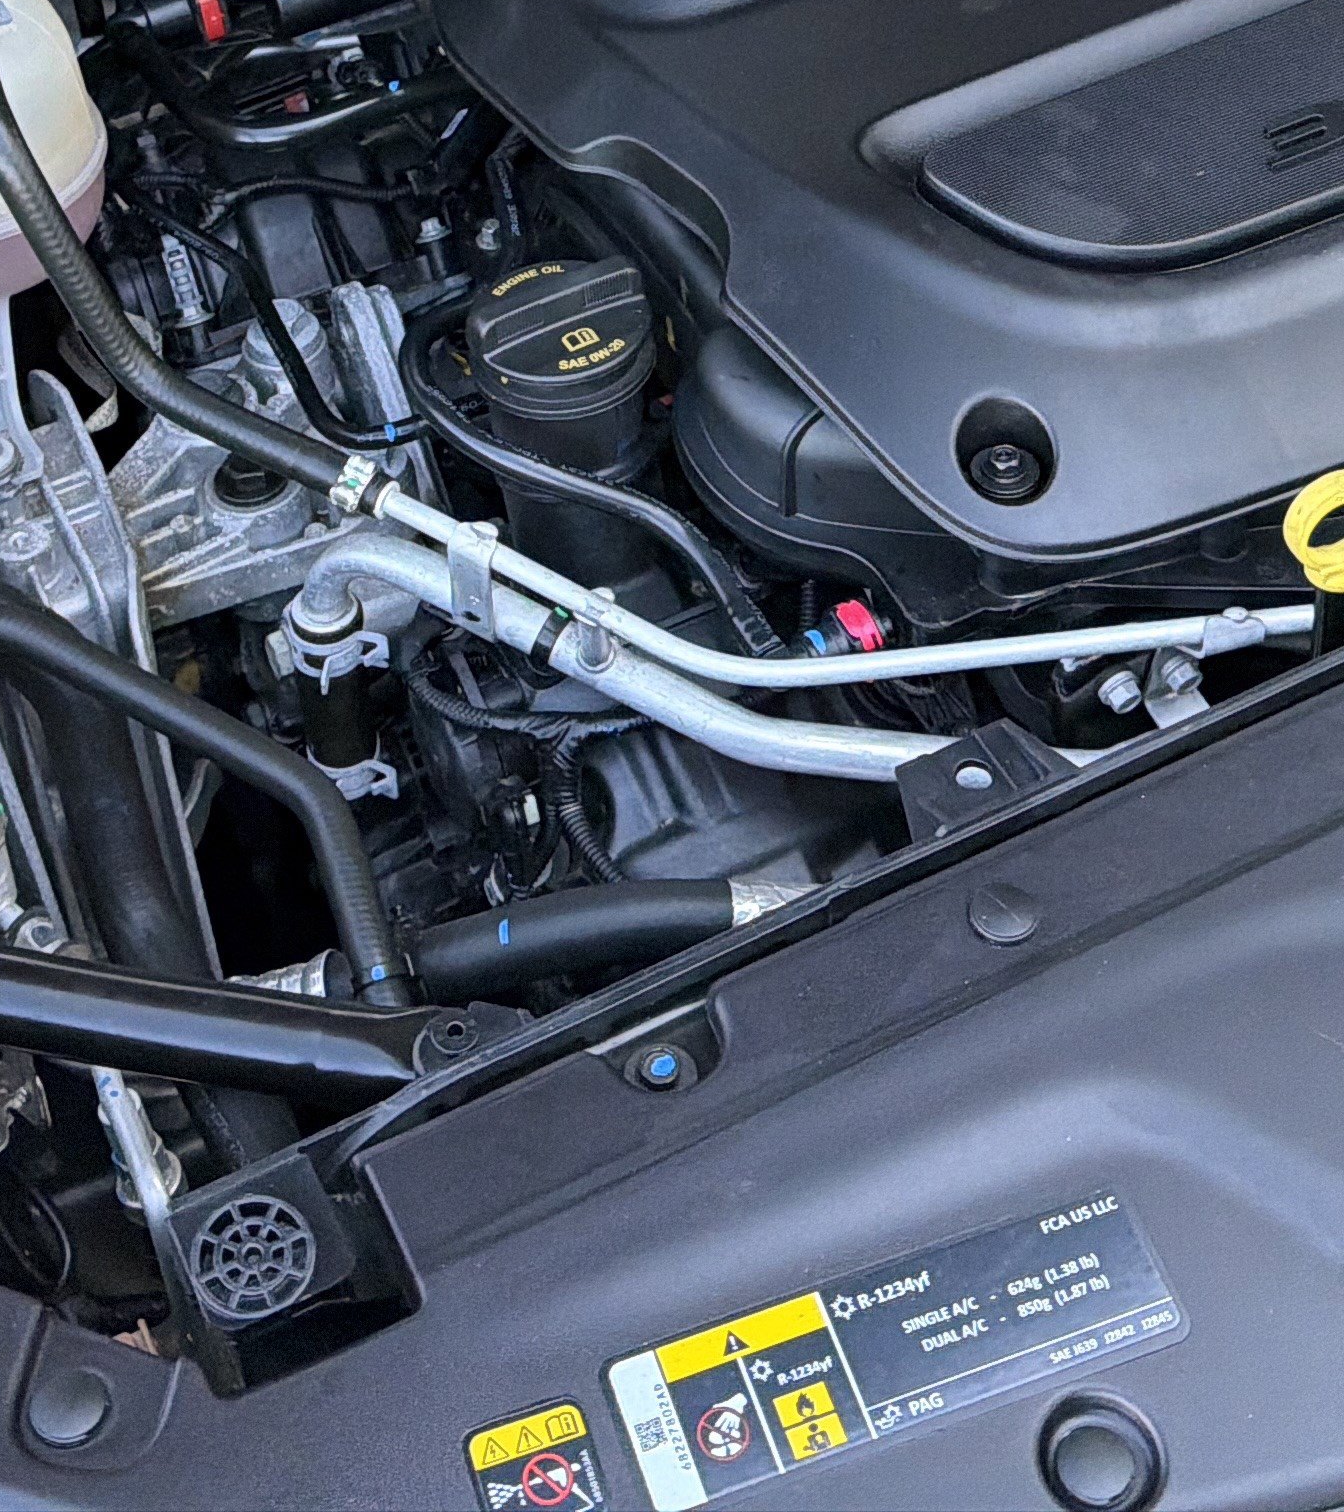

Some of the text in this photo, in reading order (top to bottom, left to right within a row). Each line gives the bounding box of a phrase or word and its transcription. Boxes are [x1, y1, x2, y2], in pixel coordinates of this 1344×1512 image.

[491, 264, 565, 297] ENGINE OIL
[558, 338, 626, 371] SAE 0W-20
[1039, 1195, 1119, 1236] FCA US LLC
[856, 1270, 932, 1311] R-1234yf
[901, 1306, 952, 1335] SINGLE
[952, 1296, 980, 1320] A/C
[1007, 1276, 1043, 1298] 624g
[1044, 1260, 1078, 1286] (1.38
[1079, 1252, 1101, 1275] lb)
[921, 1330, 961, 1354] DUAL
[962, 1318, 989, 1343] A/C
[1017, 1297, 1053, 1320] 850g
[1054, 1281, 1088, 1307] (1.87
[1089, 1273, 1111, 1297] lb)
[776, 1355, 833, 1386] R-1234yf
[1049, 1346, 1073, 1365] SAE
[908, 1392, 946, 1417] PAG
[653, 1383, 692, 1471] 68227802AD
